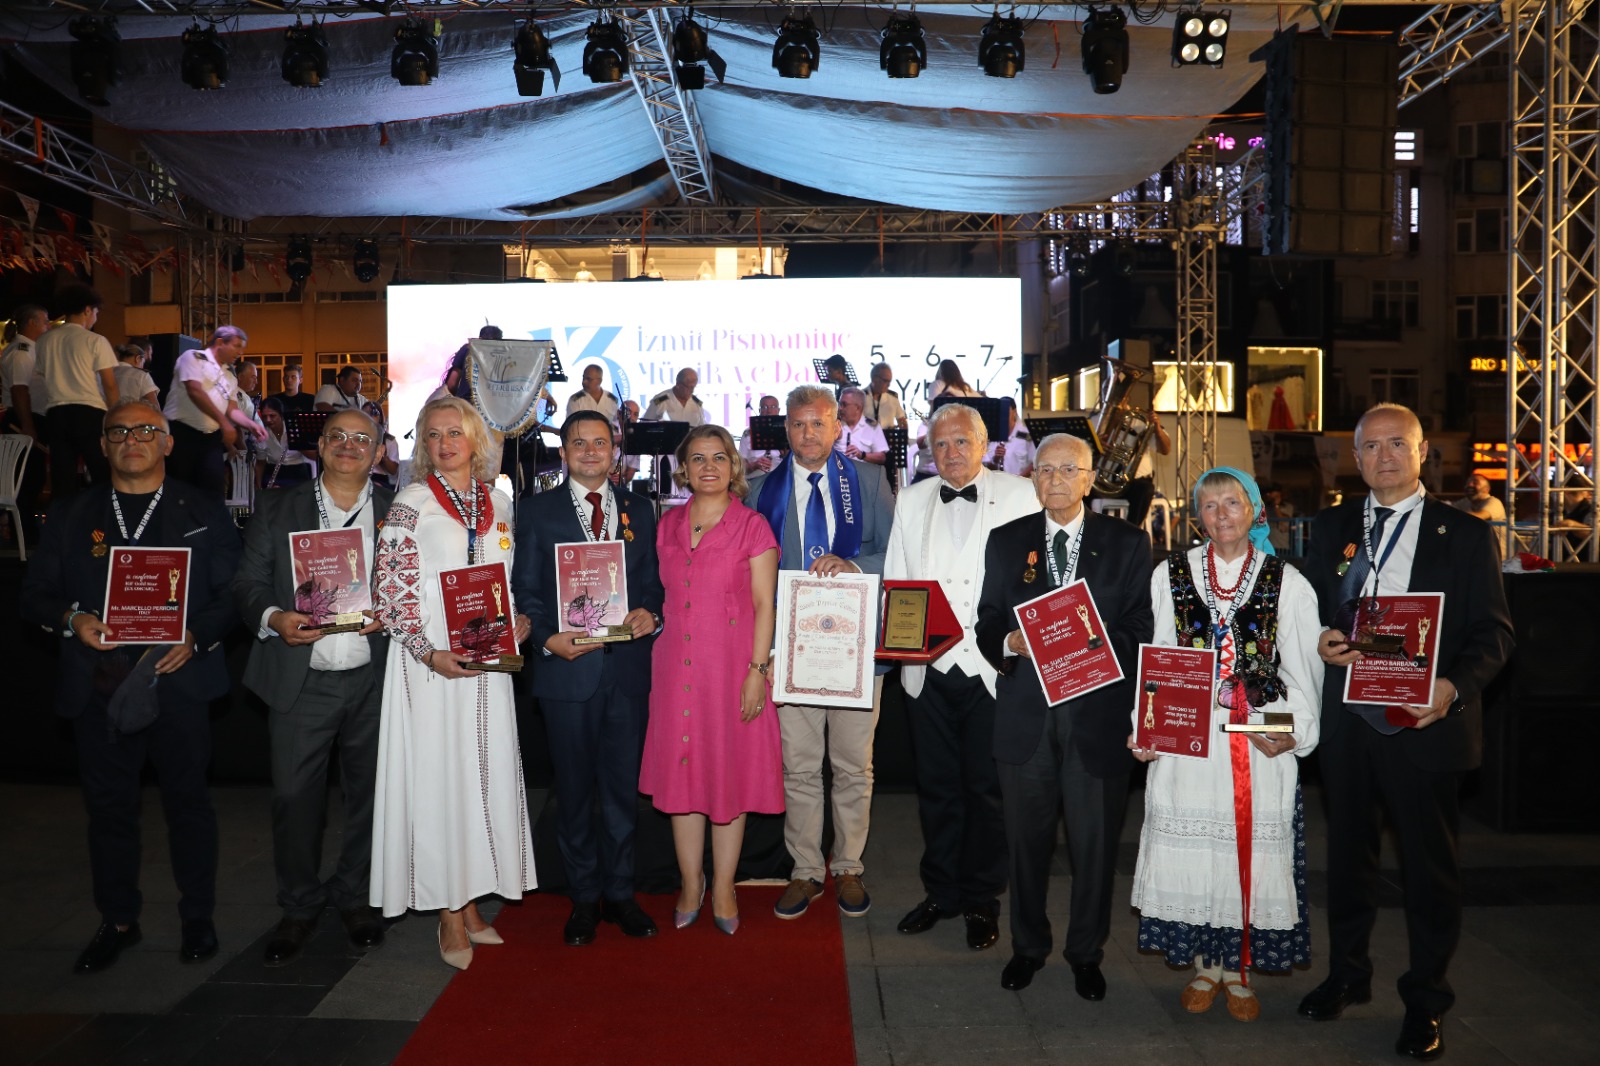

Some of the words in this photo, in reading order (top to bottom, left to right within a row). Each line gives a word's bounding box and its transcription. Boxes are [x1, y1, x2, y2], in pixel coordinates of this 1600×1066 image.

[870, 345, 885, 366] 5
[926, 345, 941, 367] 6
[980, 344, 994, 367] 7
[638, 360, 721, 386] Müik
[839, 475, 854, 524] KNIGHT
